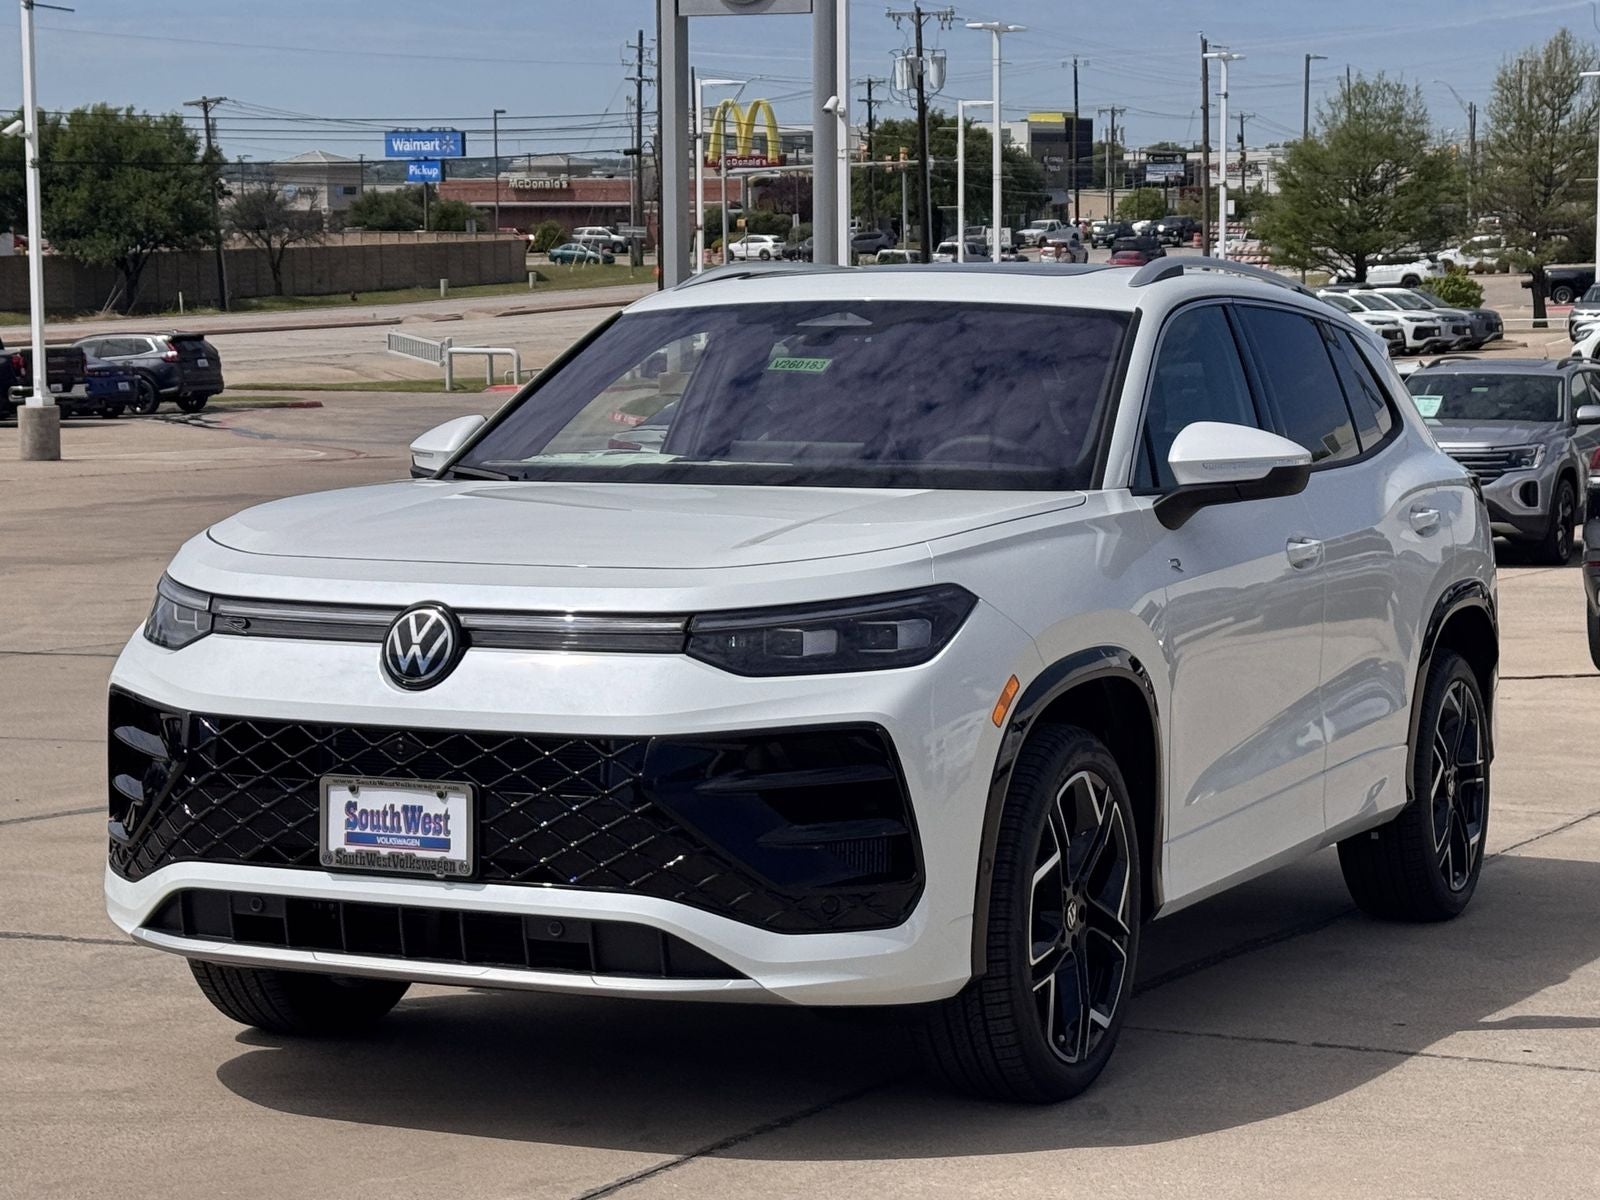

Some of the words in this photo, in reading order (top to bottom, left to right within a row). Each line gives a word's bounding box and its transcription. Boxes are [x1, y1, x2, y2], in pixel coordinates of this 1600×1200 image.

[392, 138, 440, 152] Walmart
[408, 164, 439, 178] Pickup
[508, 178, 568, 189] McDonald's
[773, 359, 826, 370] V260183
[344, 800, 451, 836] SouthWest
[376, 836, 420, 847] VOLKSWAGEN
